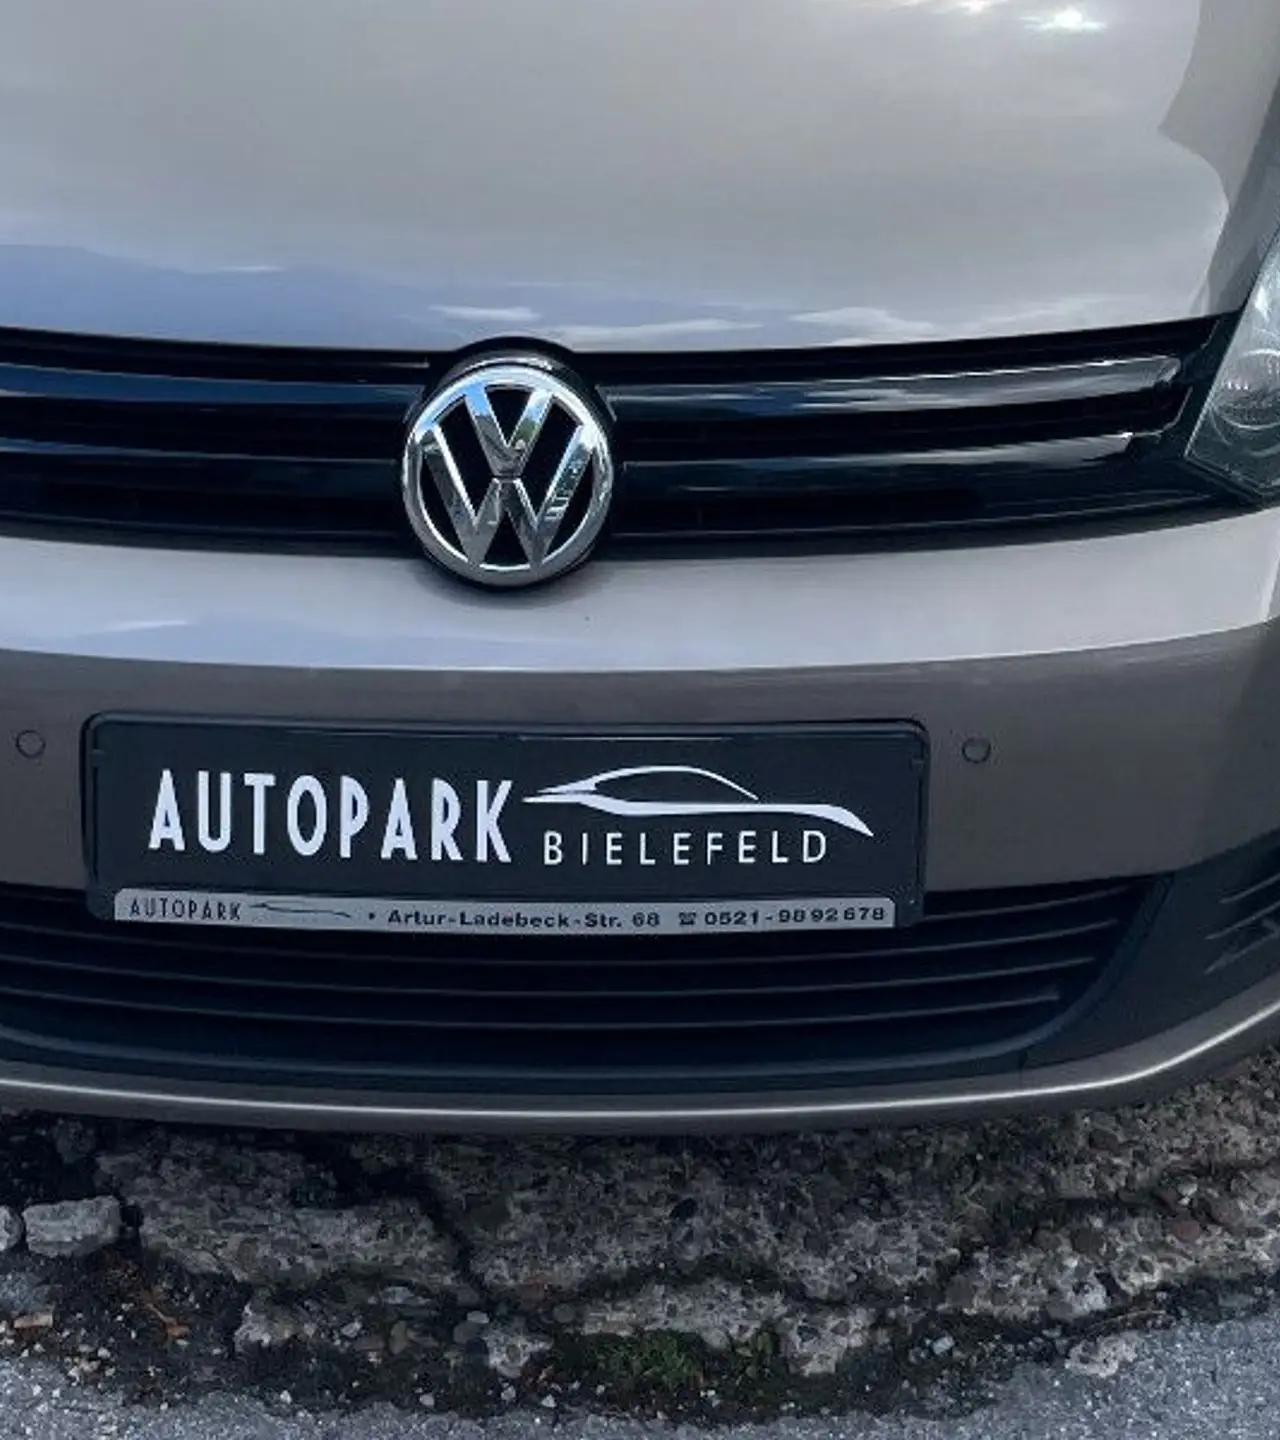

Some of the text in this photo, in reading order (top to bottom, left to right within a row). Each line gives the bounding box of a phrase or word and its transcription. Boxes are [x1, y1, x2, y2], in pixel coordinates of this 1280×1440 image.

[148, 769, 828, 866] AUTOPARK BIELEFELD
[129, 897, 242, 921] AUTOPARK
